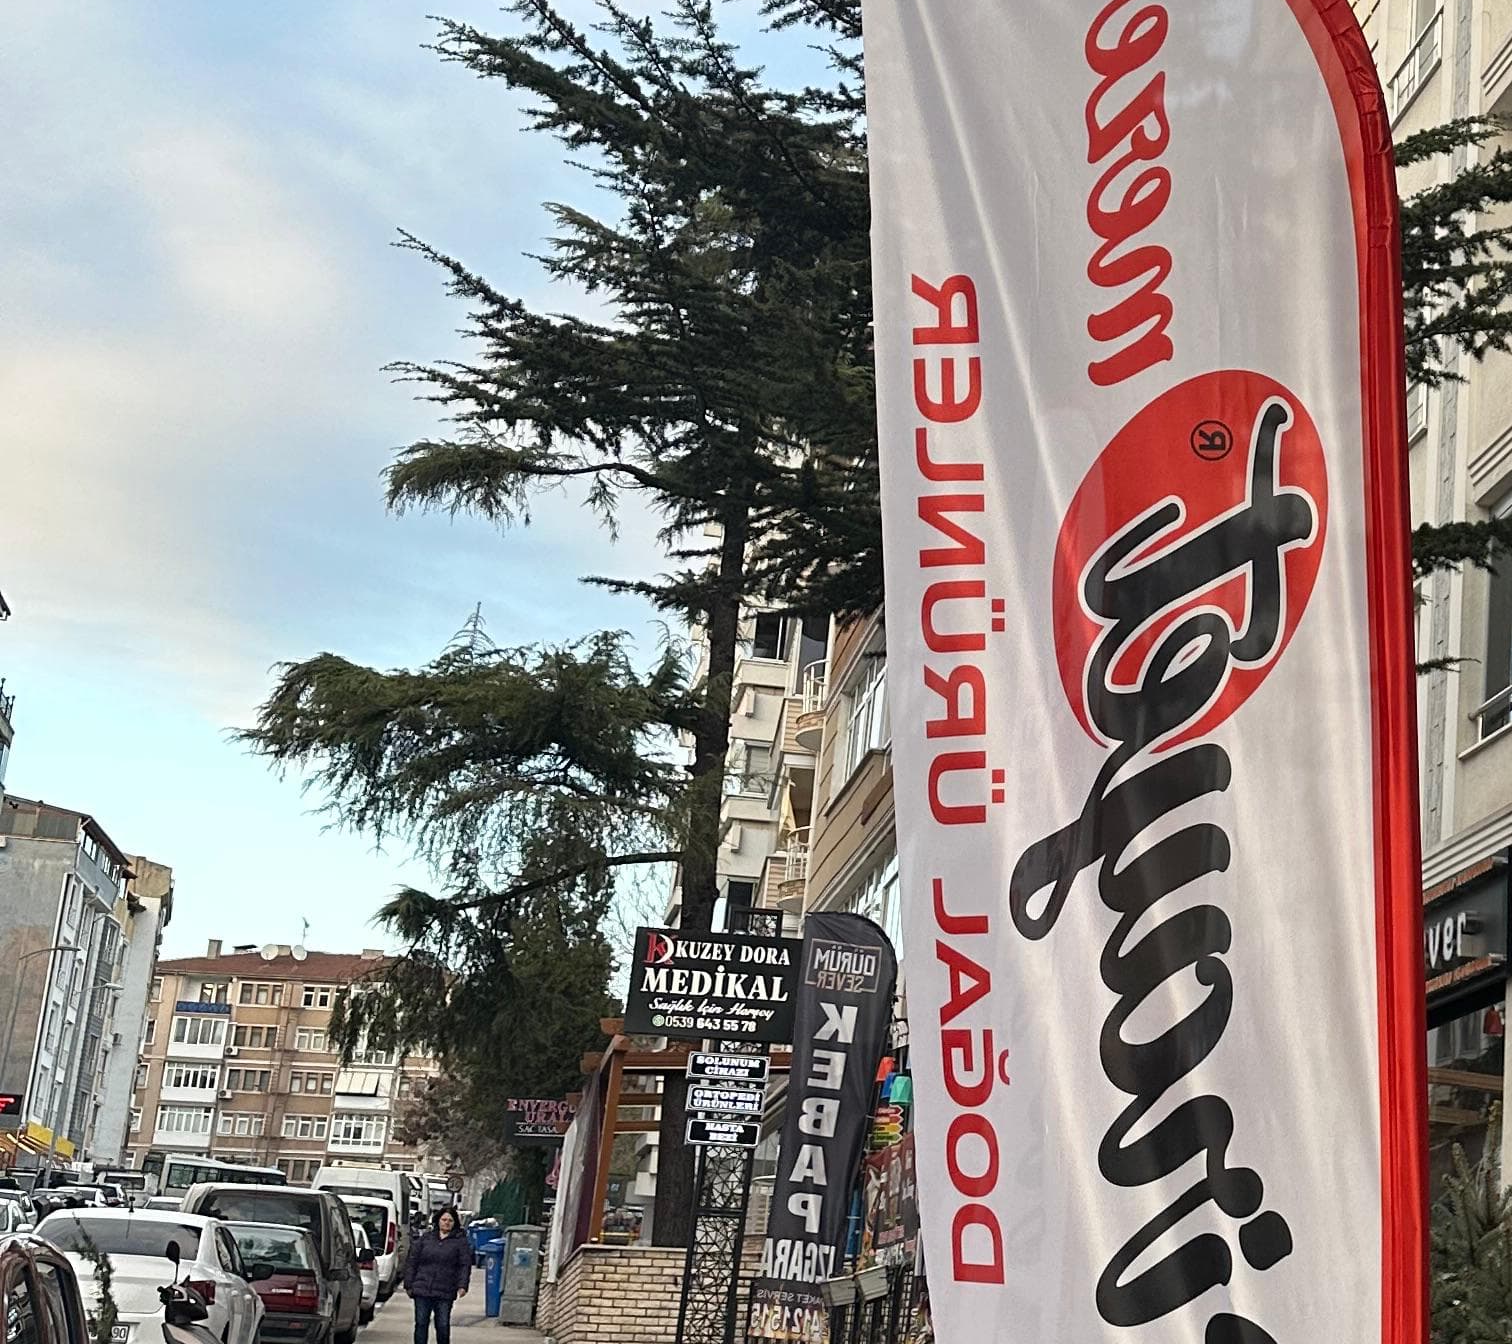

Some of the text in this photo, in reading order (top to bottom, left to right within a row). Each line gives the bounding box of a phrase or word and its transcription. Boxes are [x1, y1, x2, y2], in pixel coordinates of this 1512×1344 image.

[675, 940, 791, 966] KUZEY DORA
[640, 965, 789, 1002] MEDİKAL
[665, 1015, 694, 1029] 0539
[696, 1017, 721, 1030] 643
[723, 1019, 739, 1032] 55
[696, 1056, 760, 1069] SOLUNUM
[704, 1122, 745, 1133] HASTA
